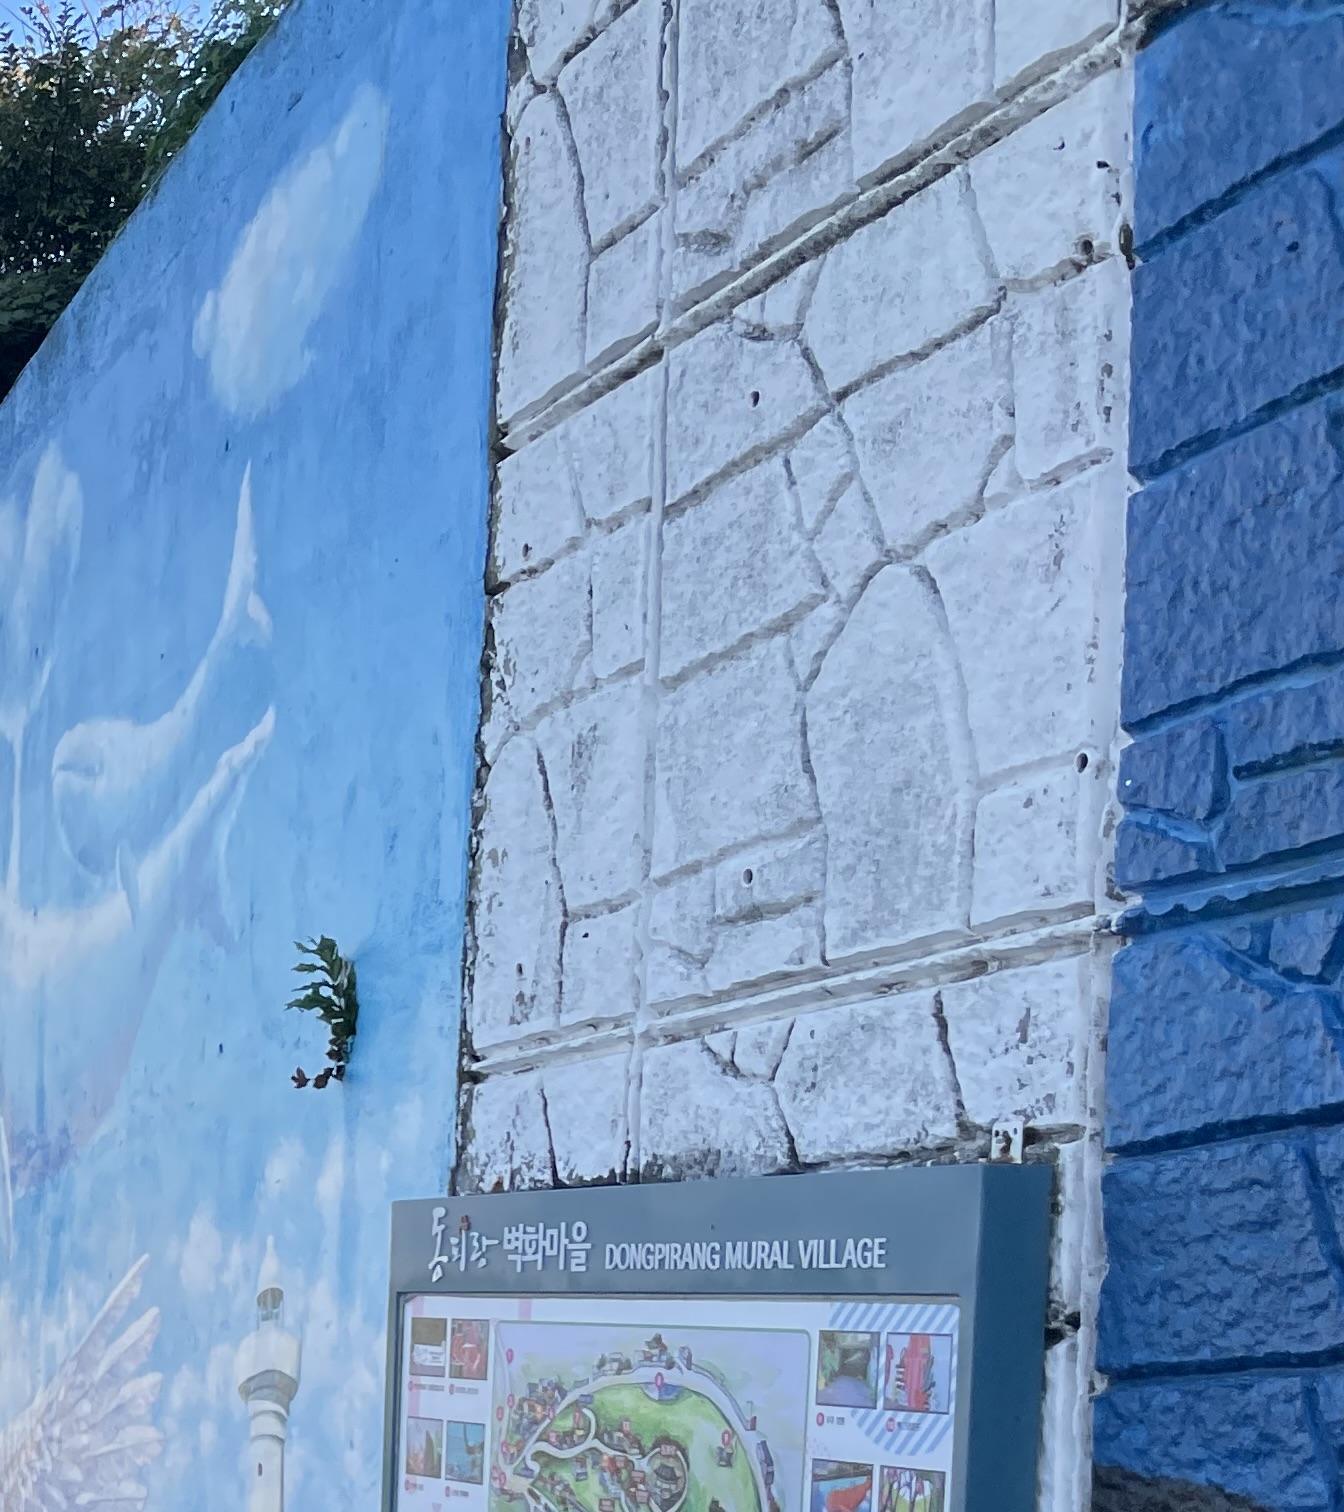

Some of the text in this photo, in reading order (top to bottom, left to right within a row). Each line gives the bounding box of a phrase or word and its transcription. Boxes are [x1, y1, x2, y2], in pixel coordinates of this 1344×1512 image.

[502, 1221, 593, 1273] 벽화마을
[604, 1241, 721, 1271] DONGPIRANG
[724, 1240, 795, 1270] MURAL
[798, 1237, 888, 1268] VILLAGE
